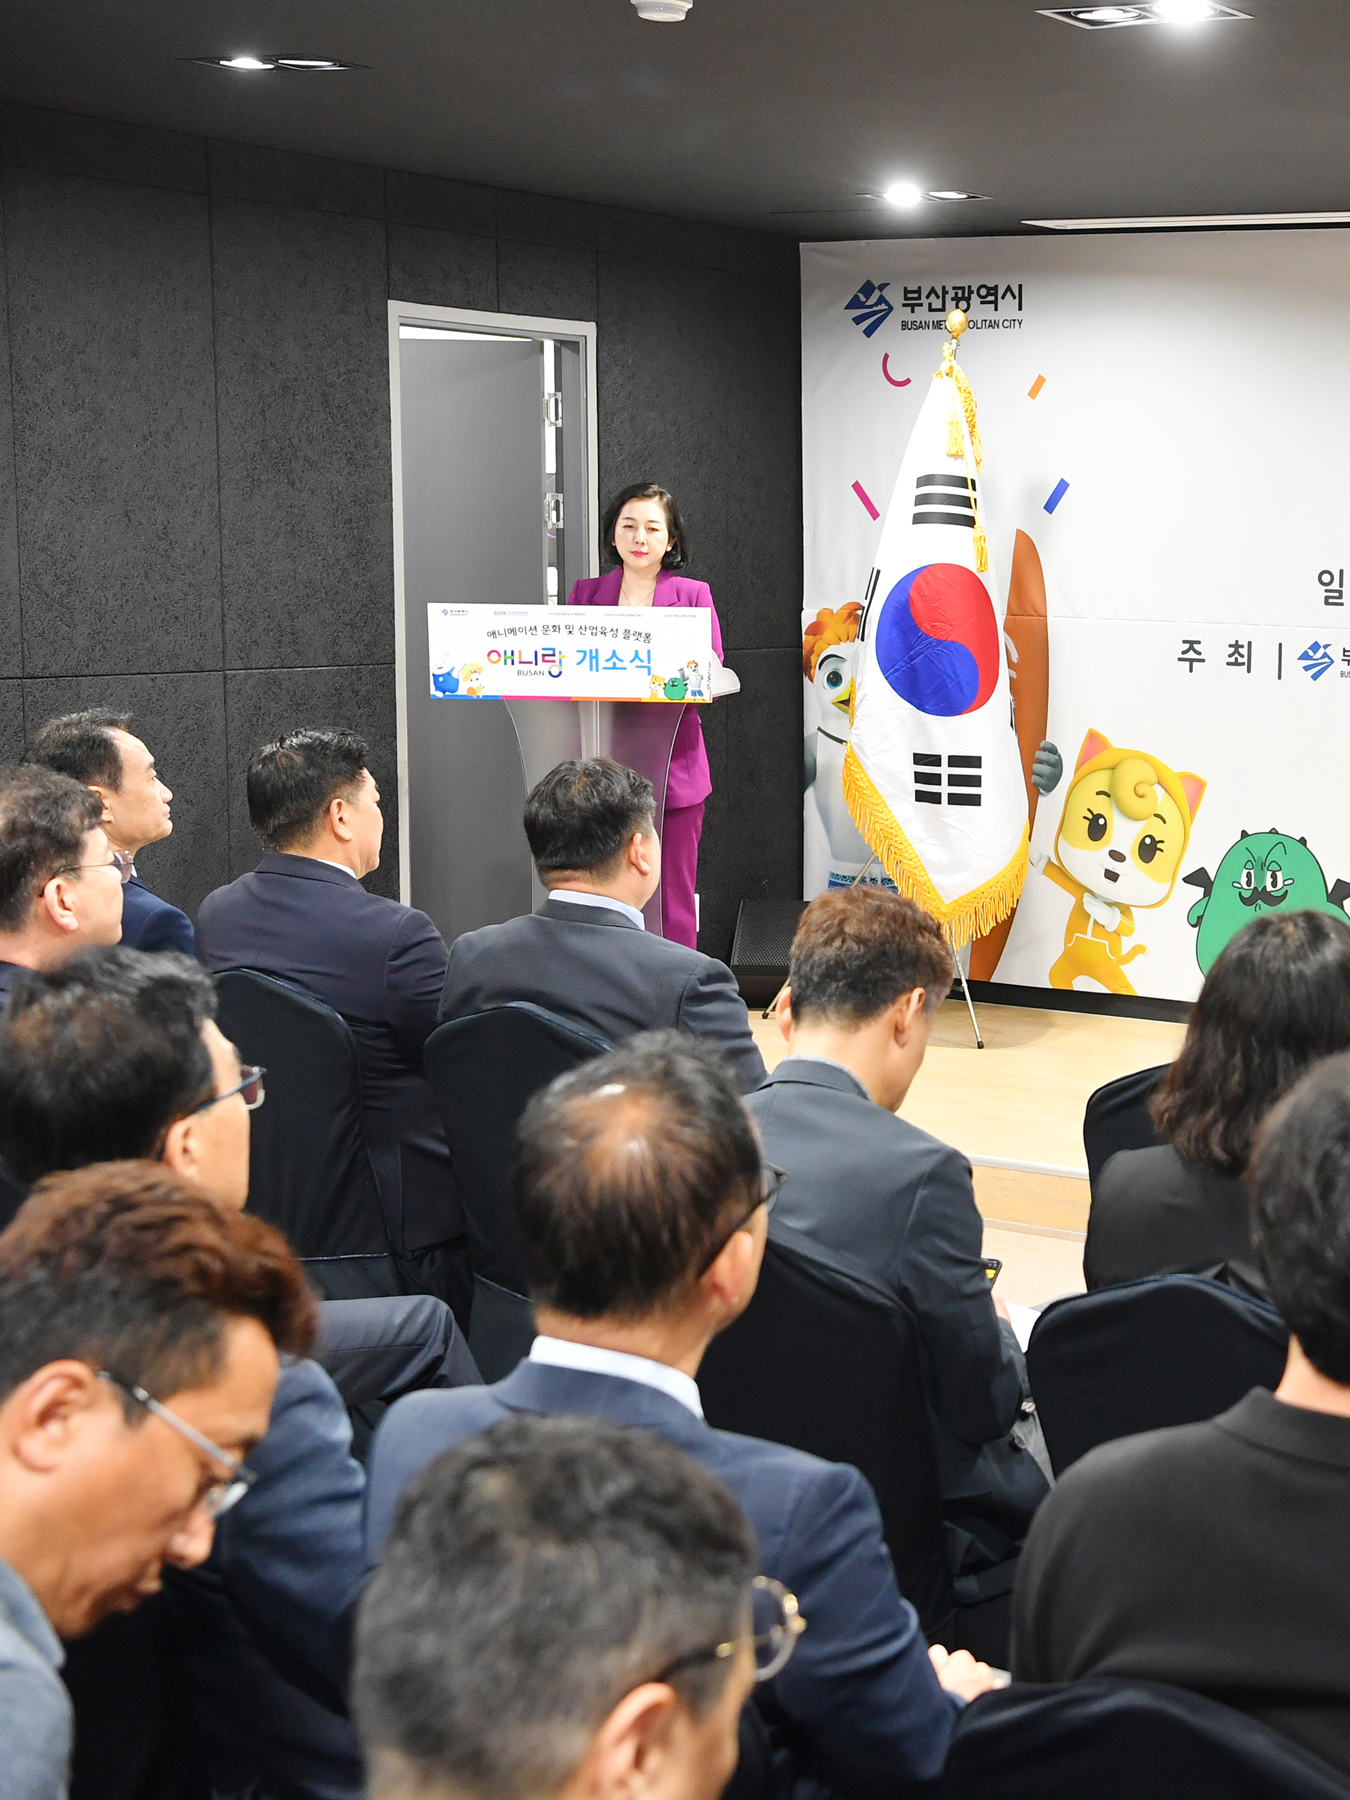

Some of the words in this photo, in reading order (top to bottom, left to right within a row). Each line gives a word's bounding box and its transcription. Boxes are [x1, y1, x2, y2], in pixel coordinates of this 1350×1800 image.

[901, 283, 1023, 314] 부산광역시
[901, 319, 930, 331] BUSAN
[932, 319, 1000, 331] METOLITAN
[1002, 318, 1023, 330] CITY
[1317, 568, 1345, 607] 일
[487, 625, 538, 639] 애니메이션
[541, 624, 561, 636] 문화
[565, 624, 574, 636] 및
[578, 624, 619, 639] 산업육성
[622, 628, 653, 644] 플랫폼
[487, 646, 566, 678] 애니랑
[575, 647, 653, 676] 개소식
[1177, 639, 1206, 674] 주
[1225, 639, 1252, 674] 최
[517, 669, 545, 677] BUSAN
